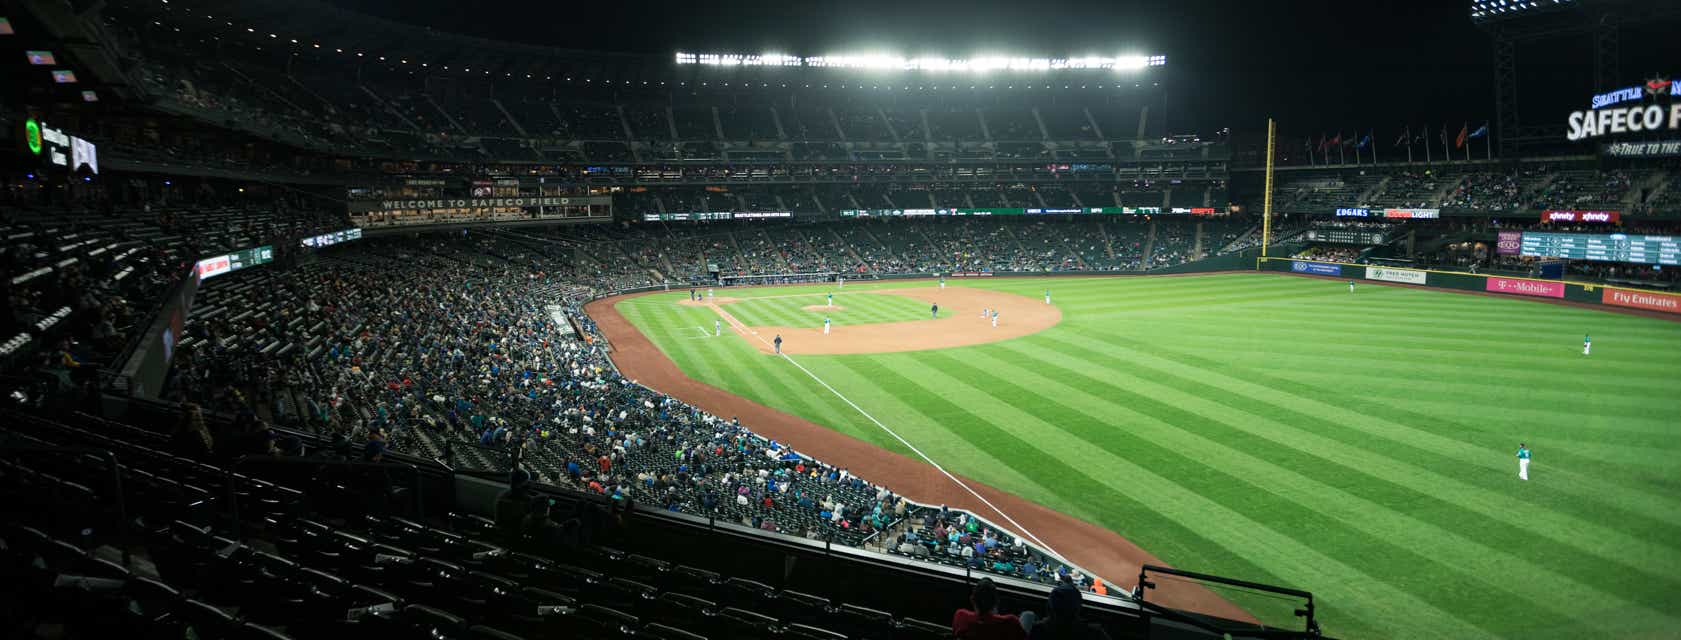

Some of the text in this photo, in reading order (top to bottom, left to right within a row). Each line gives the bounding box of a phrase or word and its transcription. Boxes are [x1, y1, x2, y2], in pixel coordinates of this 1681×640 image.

[1592, 87, 1643, 109] SEATTLE
[1567, 103, 1681, 141] SAFECO F
[1620, 143, 1681, 155] TRUE TO THE
[383, 197, 570, 209] WELCOME TO SAFECO FIELD
[1613, 292, 1677, 309] Fly Emirates
